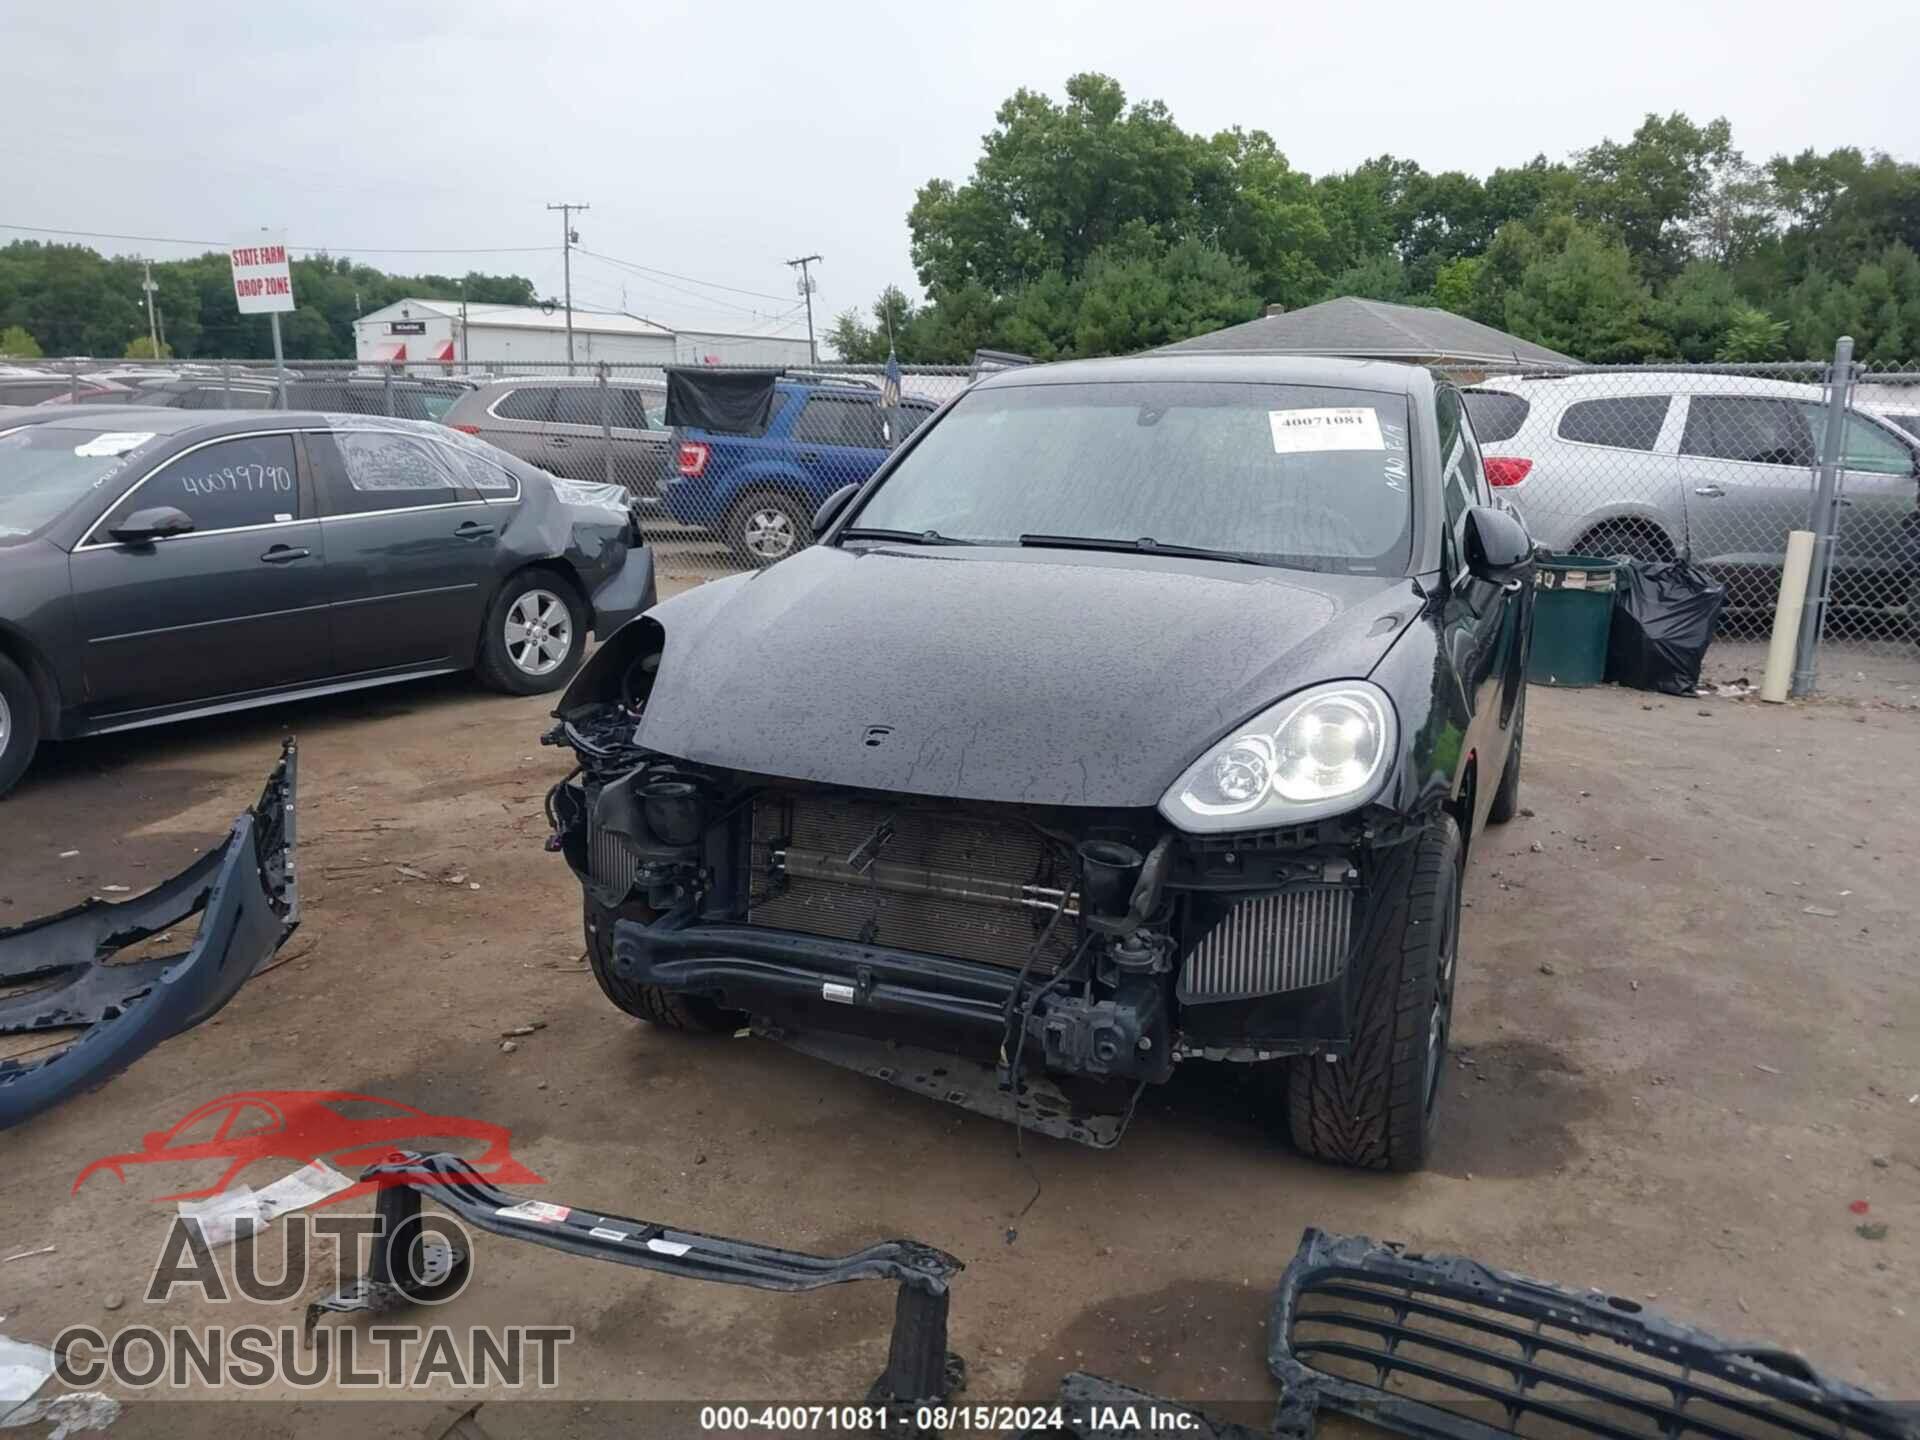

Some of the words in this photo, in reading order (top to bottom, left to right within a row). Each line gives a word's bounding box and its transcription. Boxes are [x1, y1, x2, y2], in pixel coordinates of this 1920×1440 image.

[232, 247, 259, 266] STATE
[260, 245, 286, 264] FARM
[237, 278, 263, 296] DROP
[265, 276, 290, 295] ZONE
